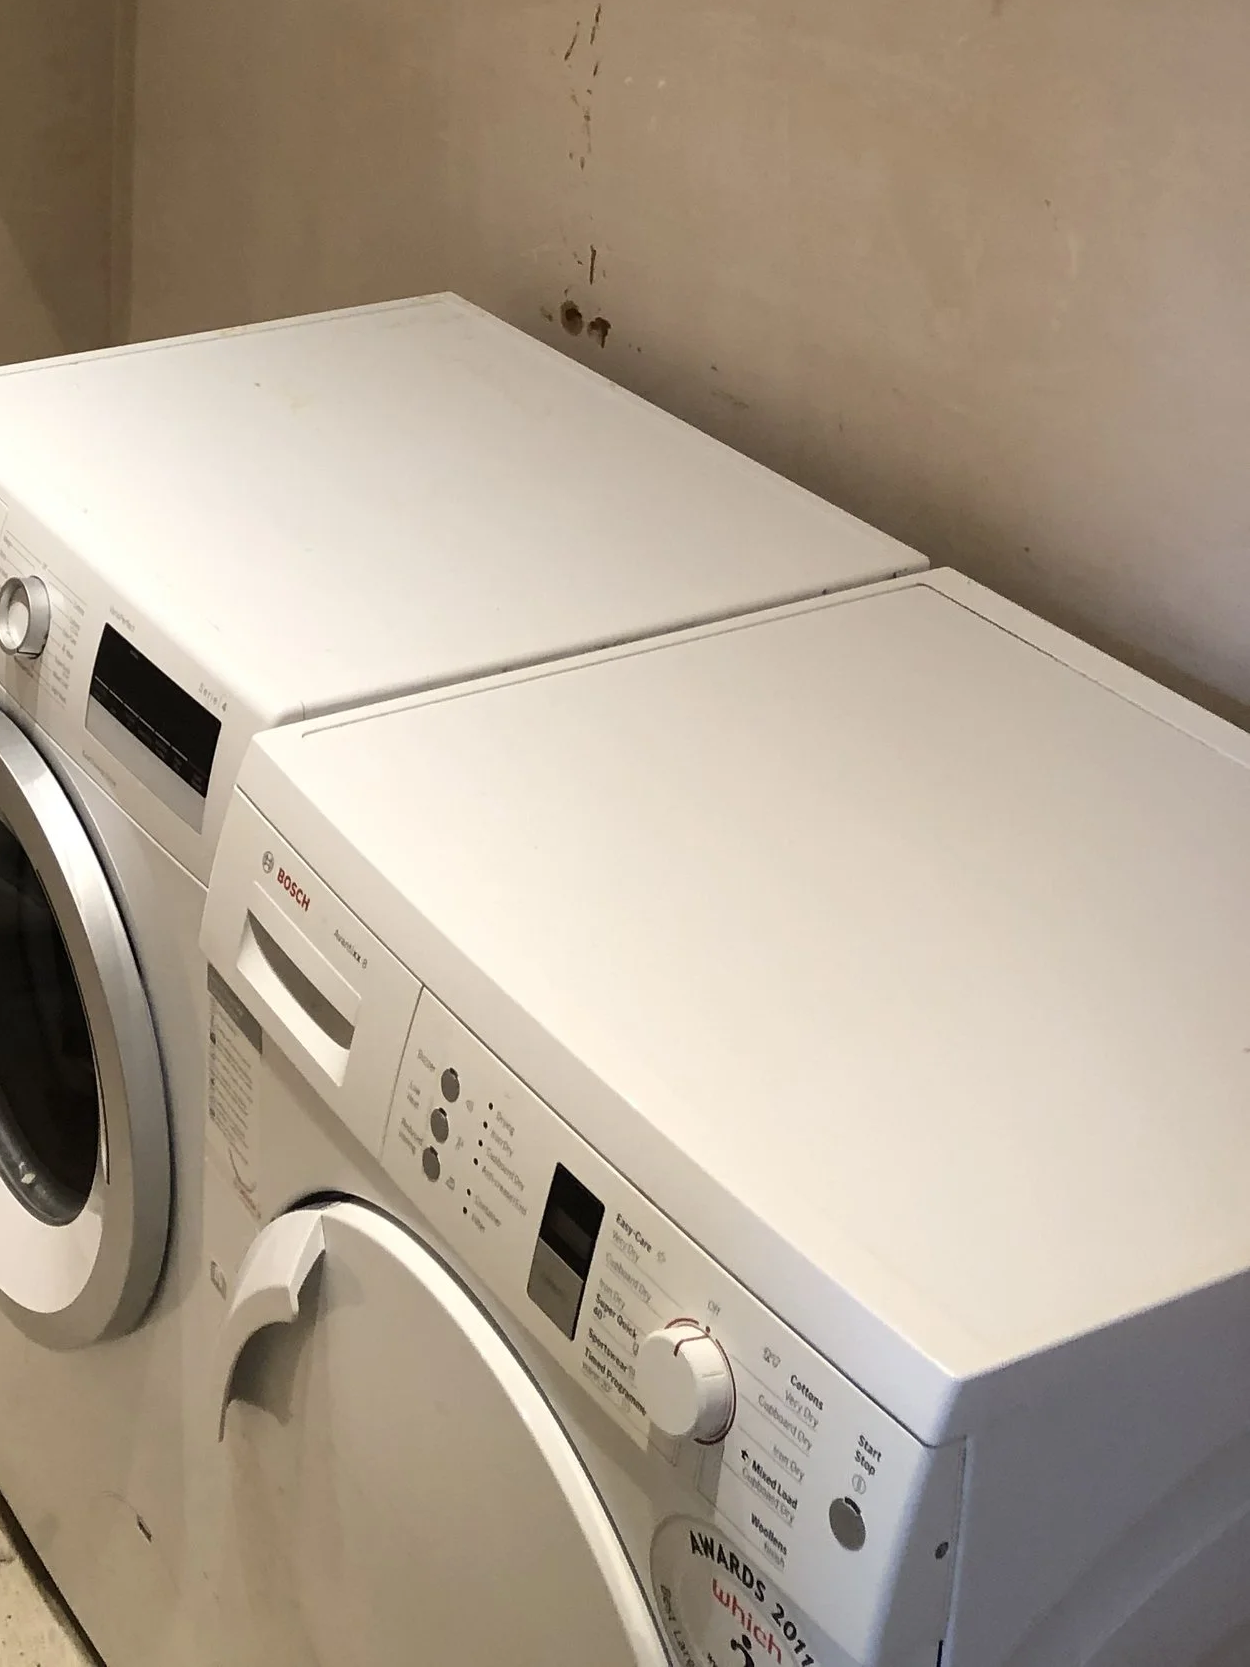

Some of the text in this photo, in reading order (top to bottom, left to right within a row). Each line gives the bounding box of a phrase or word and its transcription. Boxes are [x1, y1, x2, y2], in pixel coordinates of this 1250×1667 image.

[277, 868, 310, 911] BOSCH
[616, 1213, 652, 1253] Easy-Care
[617, 1314, 637, 1340] Quick
[607, 1369, 646, 1416] Programme
[785, 1389, 819, 1428] Very Dry
[790, 1374, 824, 1411] Cottons
[758, 1394, 813, 1452] Cupboard Dry
[855, 1450, 876, 1476] Stop
[858, 1434, 882, 1462] Start
[752, 1460, 798, 1510] Mixed Load
[790, 1461, 805, 1482] Dry
[751, 1512, 787, 1555] Woollens
[689, 1530, 814, 1667] AWARDS 2011
[712, 1577, 781, 1665] which
